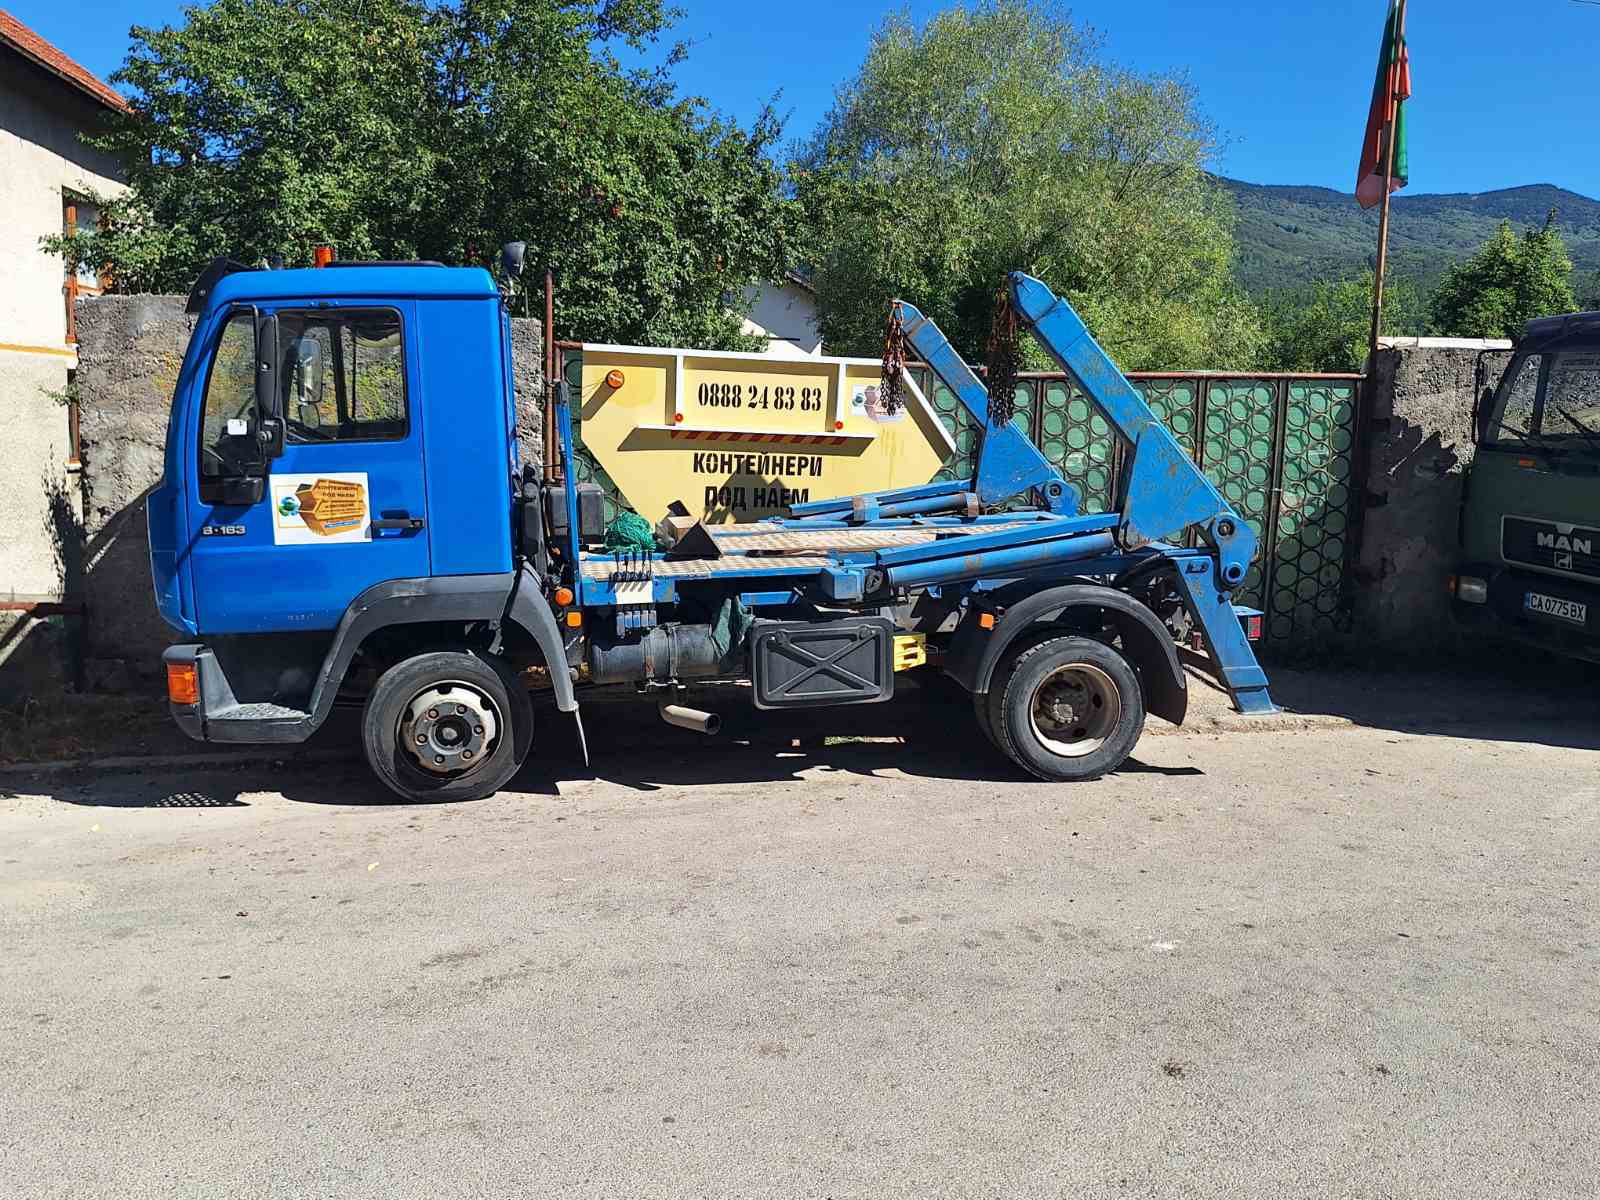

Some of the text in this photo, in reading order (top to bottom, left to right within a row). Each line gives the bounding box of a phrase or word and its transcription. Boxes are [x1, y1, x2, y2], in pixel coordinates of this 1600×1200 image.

[698, 382, 822, 411] 0888 24 83 83
[693, 451, 823, 476] КОНТЕЙНЕРИ
[704, 485, 809, 512] ПОД НАЕМ
[1536, 531, 1592, 555] MAN
